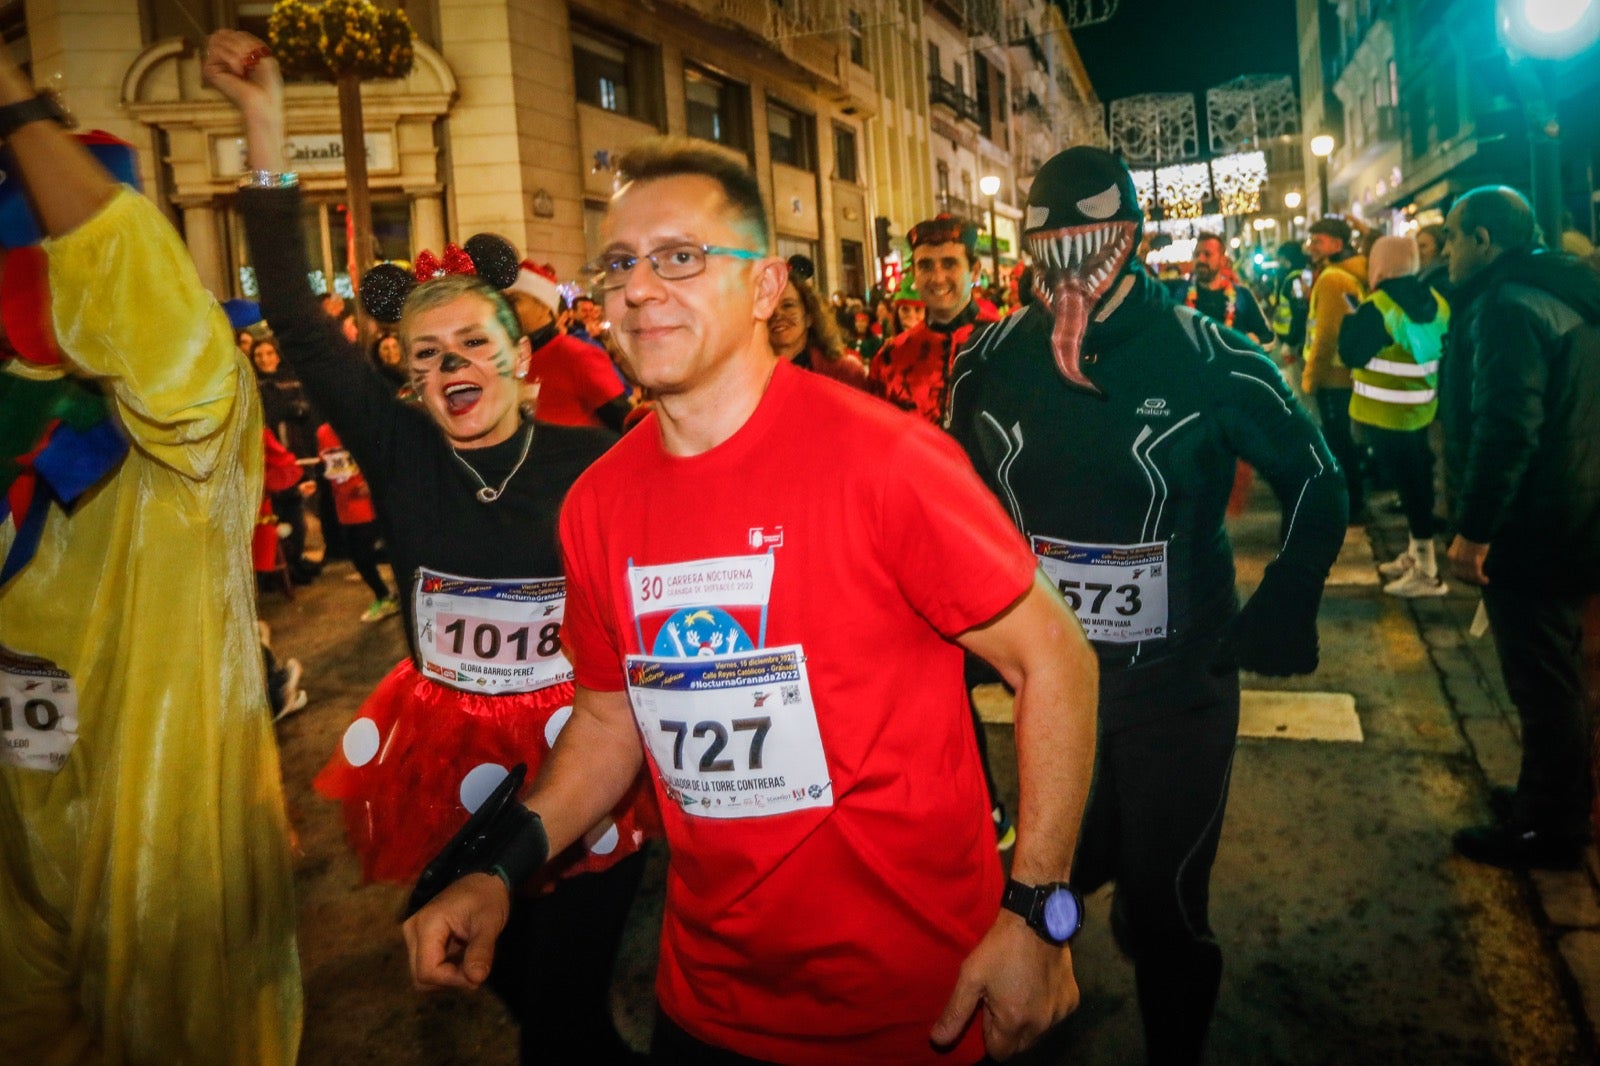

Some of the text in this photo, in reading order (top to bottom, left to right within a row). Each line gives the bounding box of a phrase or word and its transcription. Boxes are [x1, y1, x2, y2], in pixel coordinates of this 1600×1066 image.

[284, 142, 371, 161] CaixaB
[666, 568, 753, 587] CARRERA NOCTURNA
[496, 590, 566, 602] #NocturnaGranada2
[641, 576, 663, 601] 30
[1058, 579, 1142, 616] 573
[1092, 618, 1114, 627] MARTIN
[1114, 620, 1131, 628] VIANA
[444, 618, 561, 661] 1018
[460, 662, 534, 677] GLORIA BARRIOS PEREZ
[715, 662, 739, 670] Viernes,
[748, 657, 779, 666] diciembre
[779, 653, 795, 662] 2022
[690, 670, 799, 689] #NocturnaGranada2022
[702, 671, 717, 679] Calle
[717, 669, 736, 679] Reyes
[737, 667, 766, 677] Católicos
[770, 664, 797, 672] Granada
[660, 716, 772, 772] 727
[692, 780, 700, 791] DE
[701, 780, 710, 792] LA
[711, 779, 735, 792] TORRE
[737, 776, 786, 790] CONTRERAS
